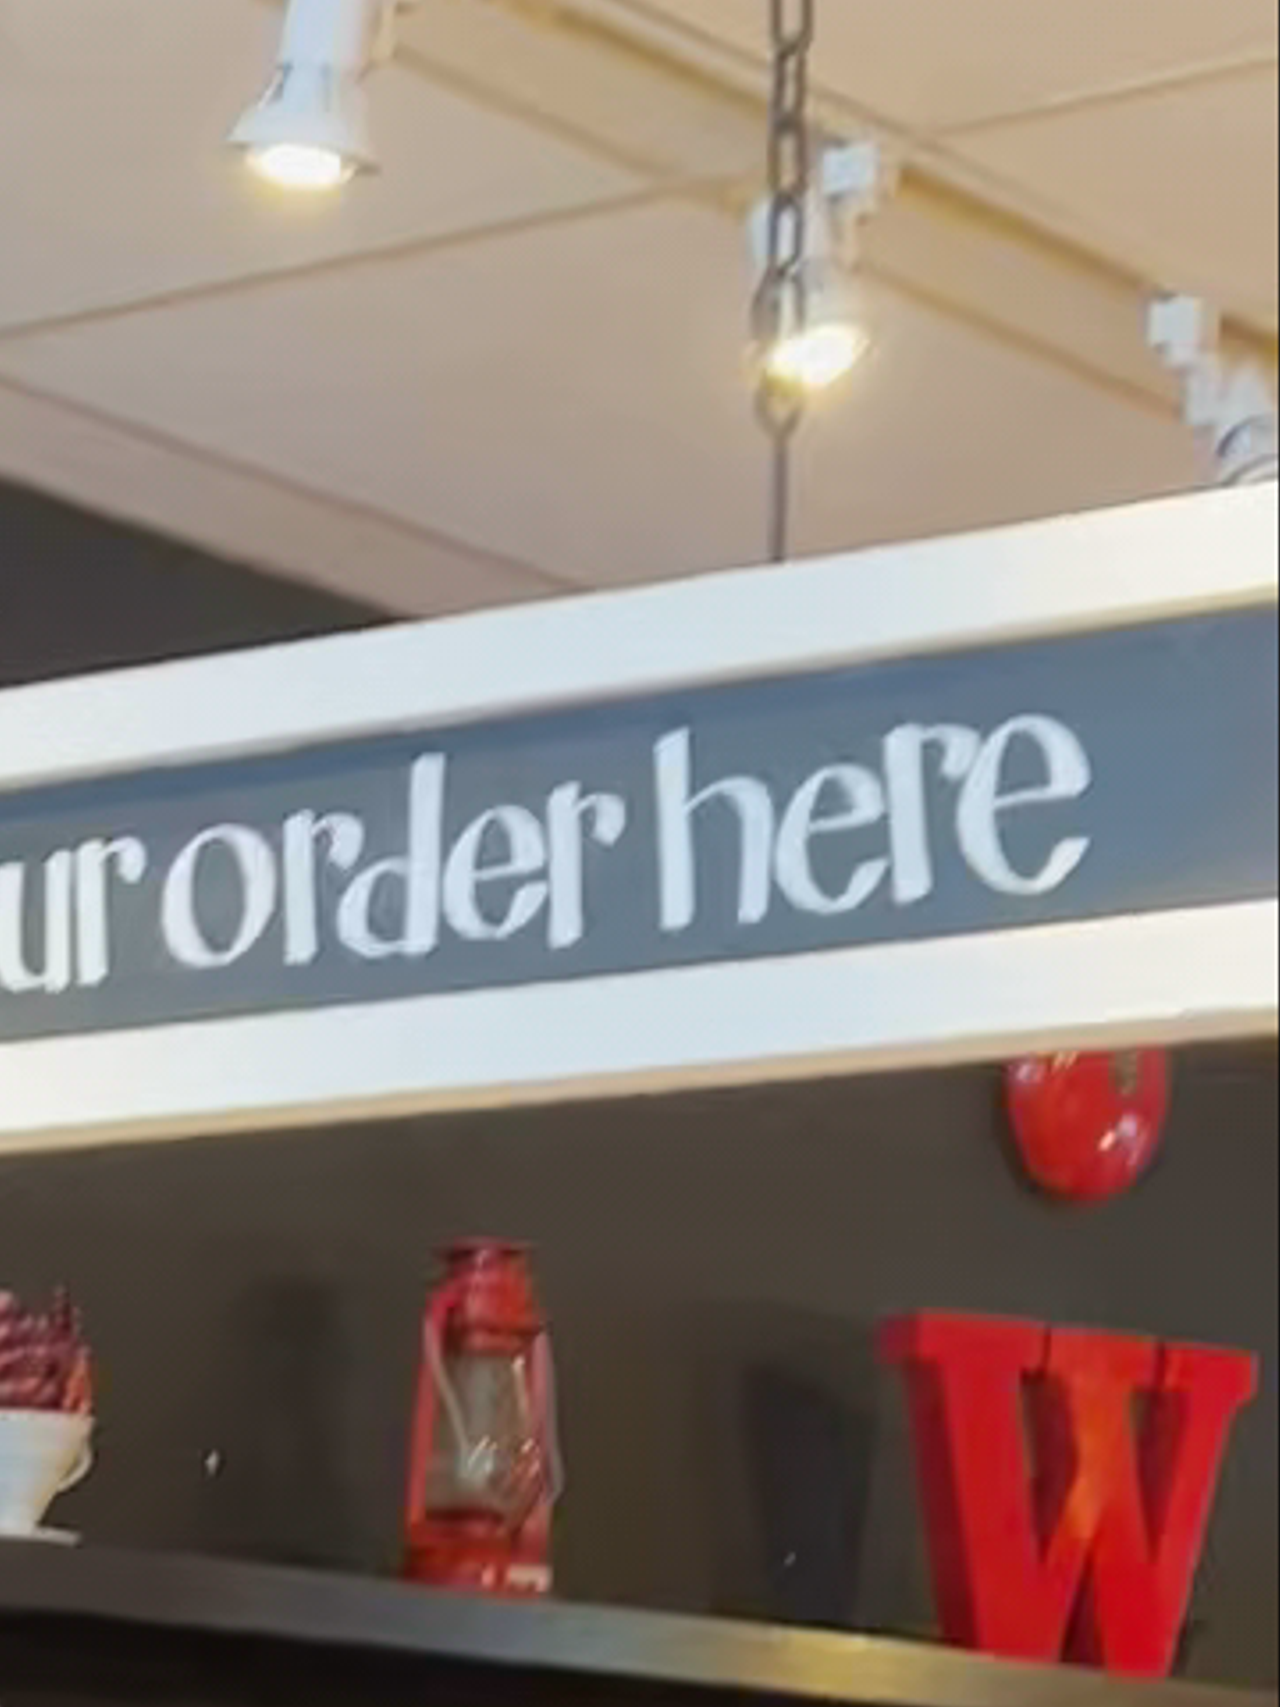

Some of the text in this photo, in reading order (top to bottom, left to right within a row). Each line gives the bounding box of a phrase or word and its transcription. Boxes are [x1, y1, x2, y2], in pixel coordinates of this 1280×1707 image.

[159, 753, 627, 969] order
[654, 713, 1092, 932] here
[876, 1309, 1258, 1679] W
